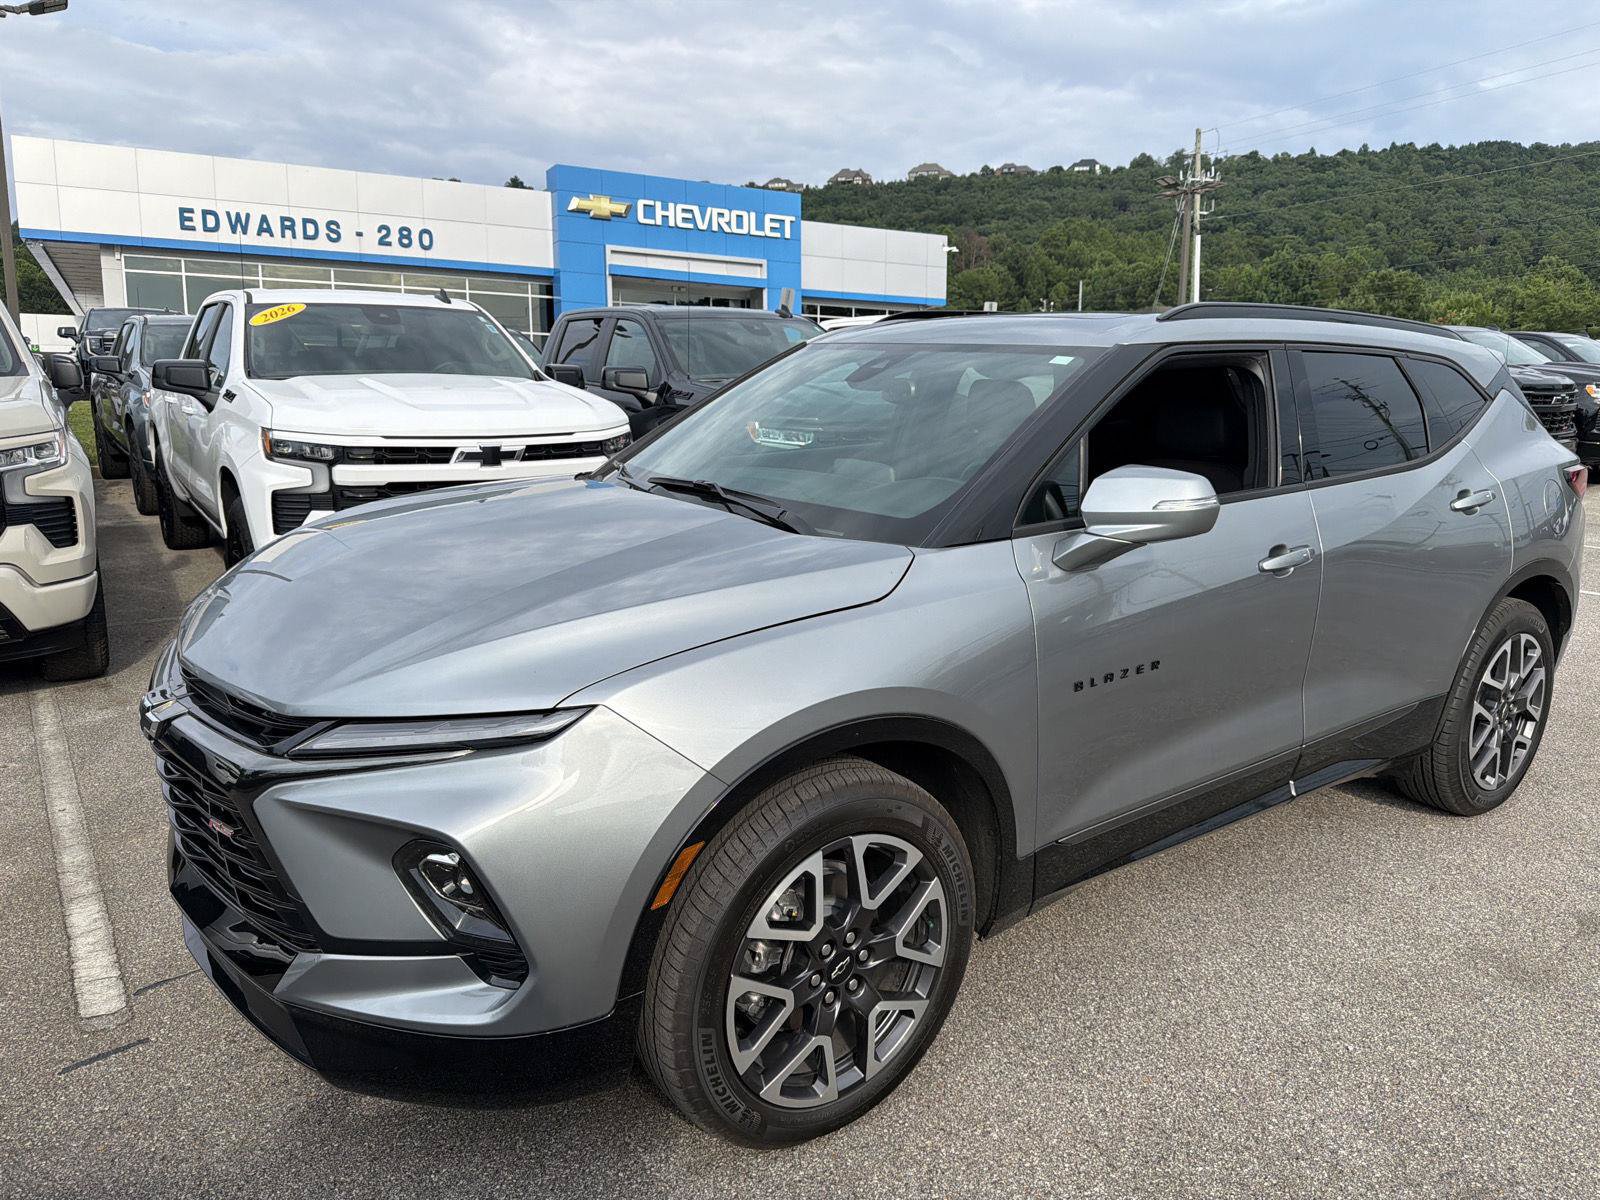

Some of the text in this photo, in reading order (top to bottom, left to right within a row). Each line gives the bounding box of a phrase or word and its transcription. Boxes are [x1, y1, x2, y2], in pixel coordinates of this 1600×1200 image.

[178, 206, 342, 243] EDWARDS
[377, 224, 434, 250] 280
[636, 198, 797, 240] CHEVROLET
[261, 305, 296, 322] 2026
[1073, 659, 1161, 692] BLAZER
[942, 843, 969, 918] MICHELIN
[700, 1032, 741, 1115] MICHELIN
